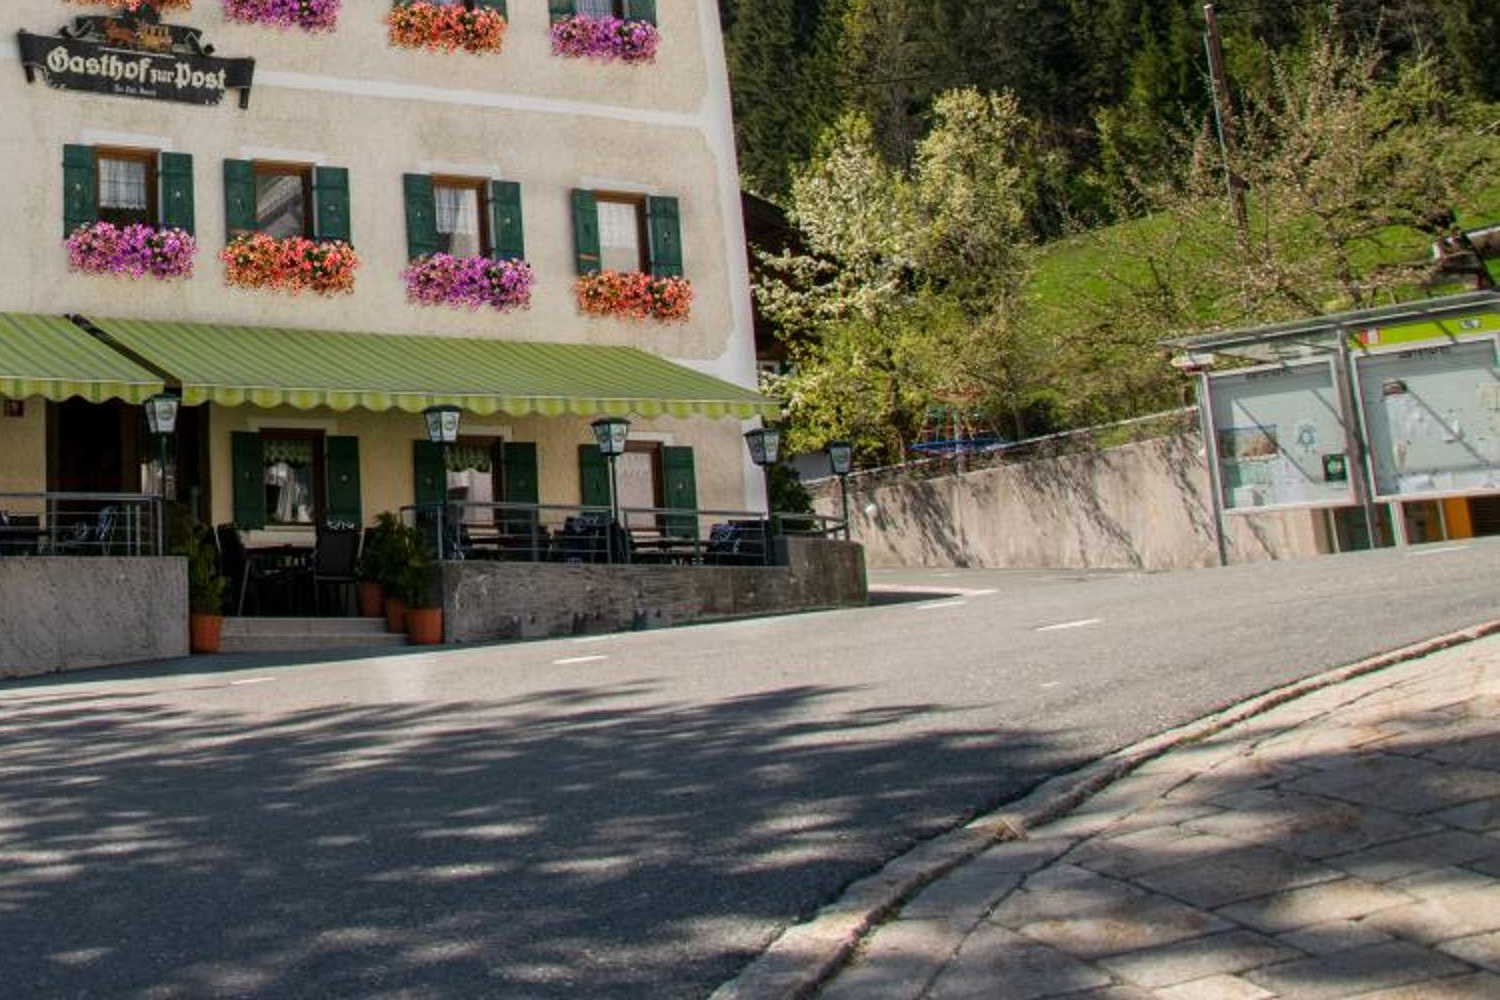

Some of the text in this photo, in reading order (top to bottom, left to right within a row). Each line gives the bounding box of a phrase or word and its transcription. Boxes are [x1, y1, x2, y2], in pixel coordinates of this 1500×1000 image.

[47, 45, 227, 89] Gasthof zur Post
